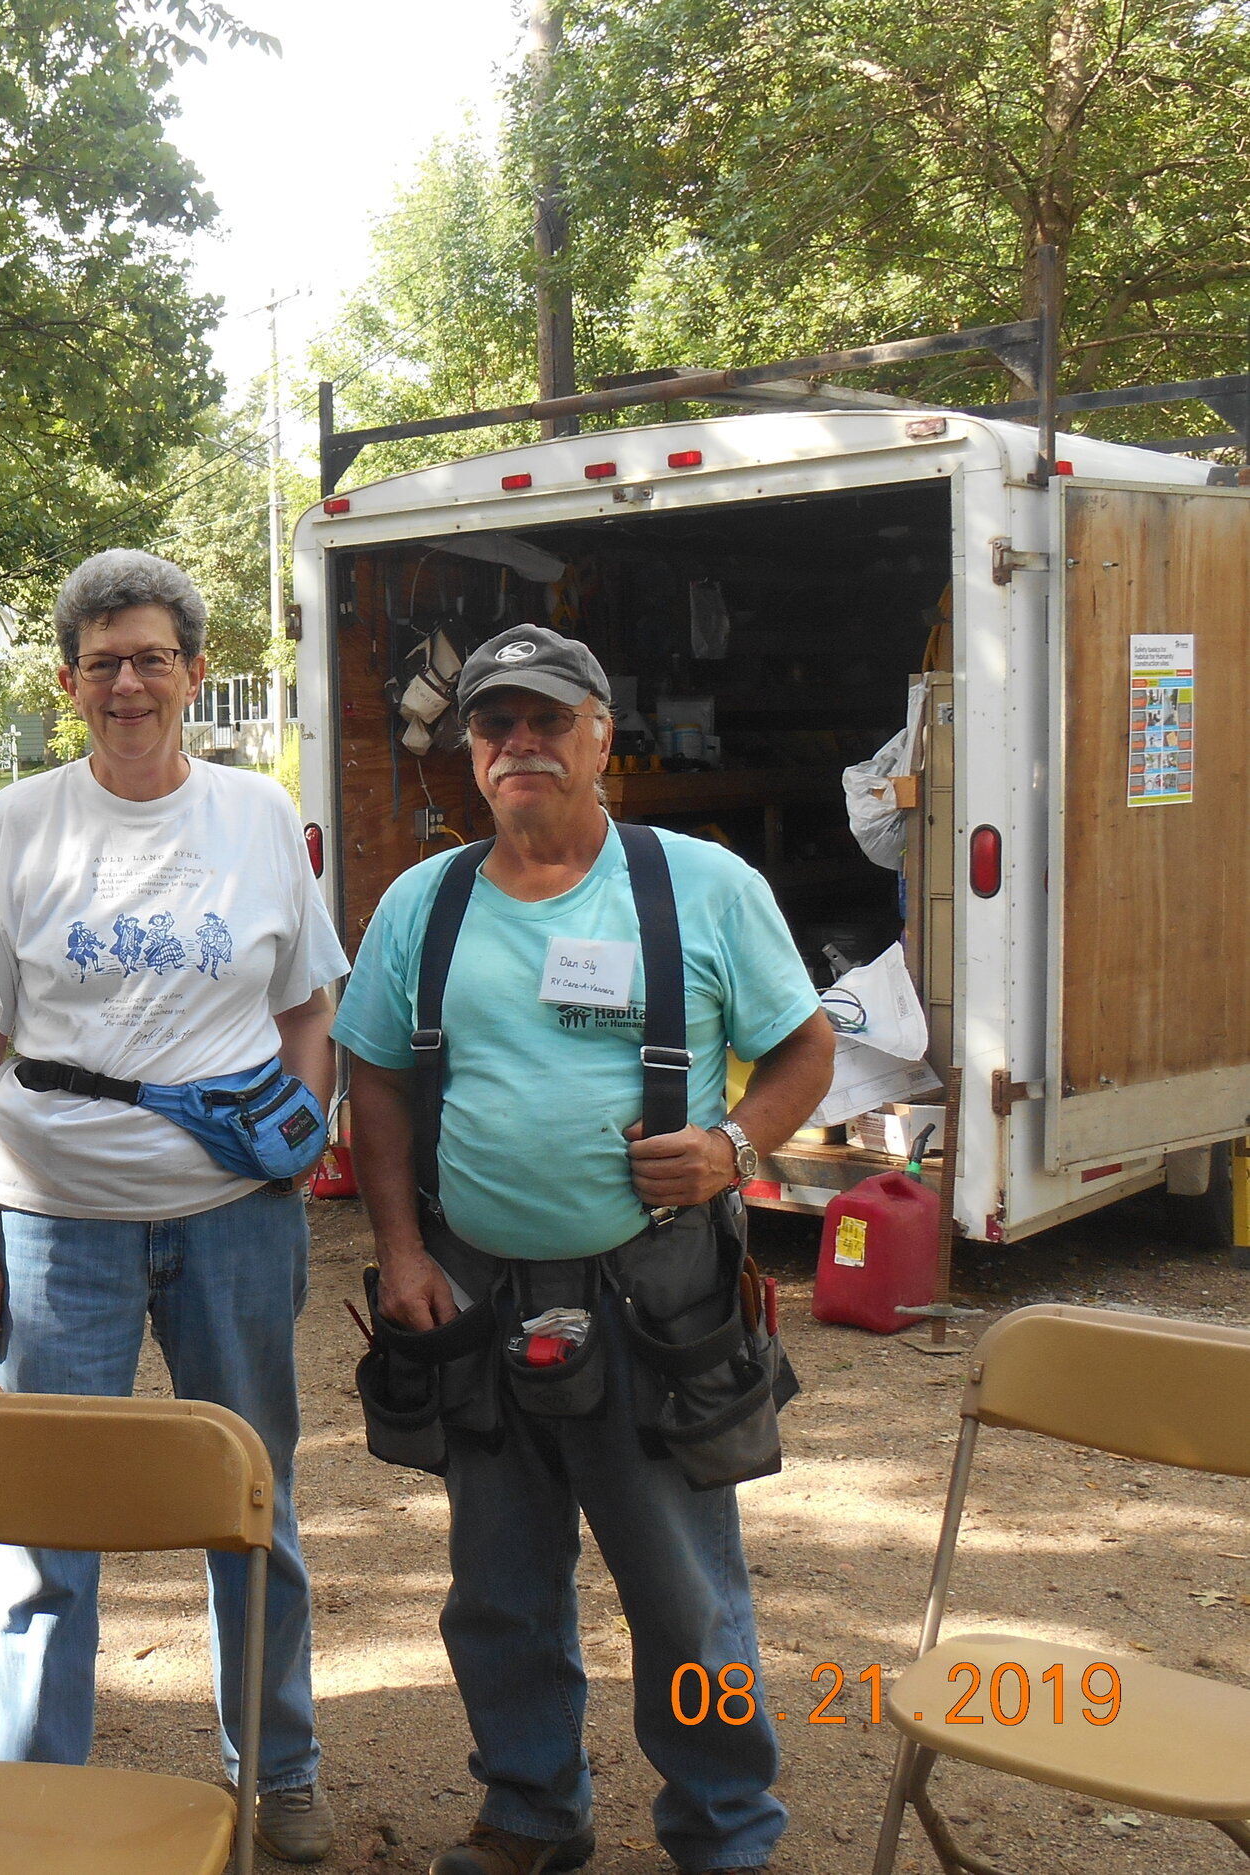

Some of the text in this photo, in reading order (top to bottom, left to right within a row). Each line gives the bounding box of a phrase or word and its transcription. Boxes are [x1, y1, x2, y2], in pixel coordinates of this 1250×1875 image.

[559, 956, 597, 975] Dan Sly
[550, 977, 561, 985] RV
[595, 1020, 608, 1028] for
